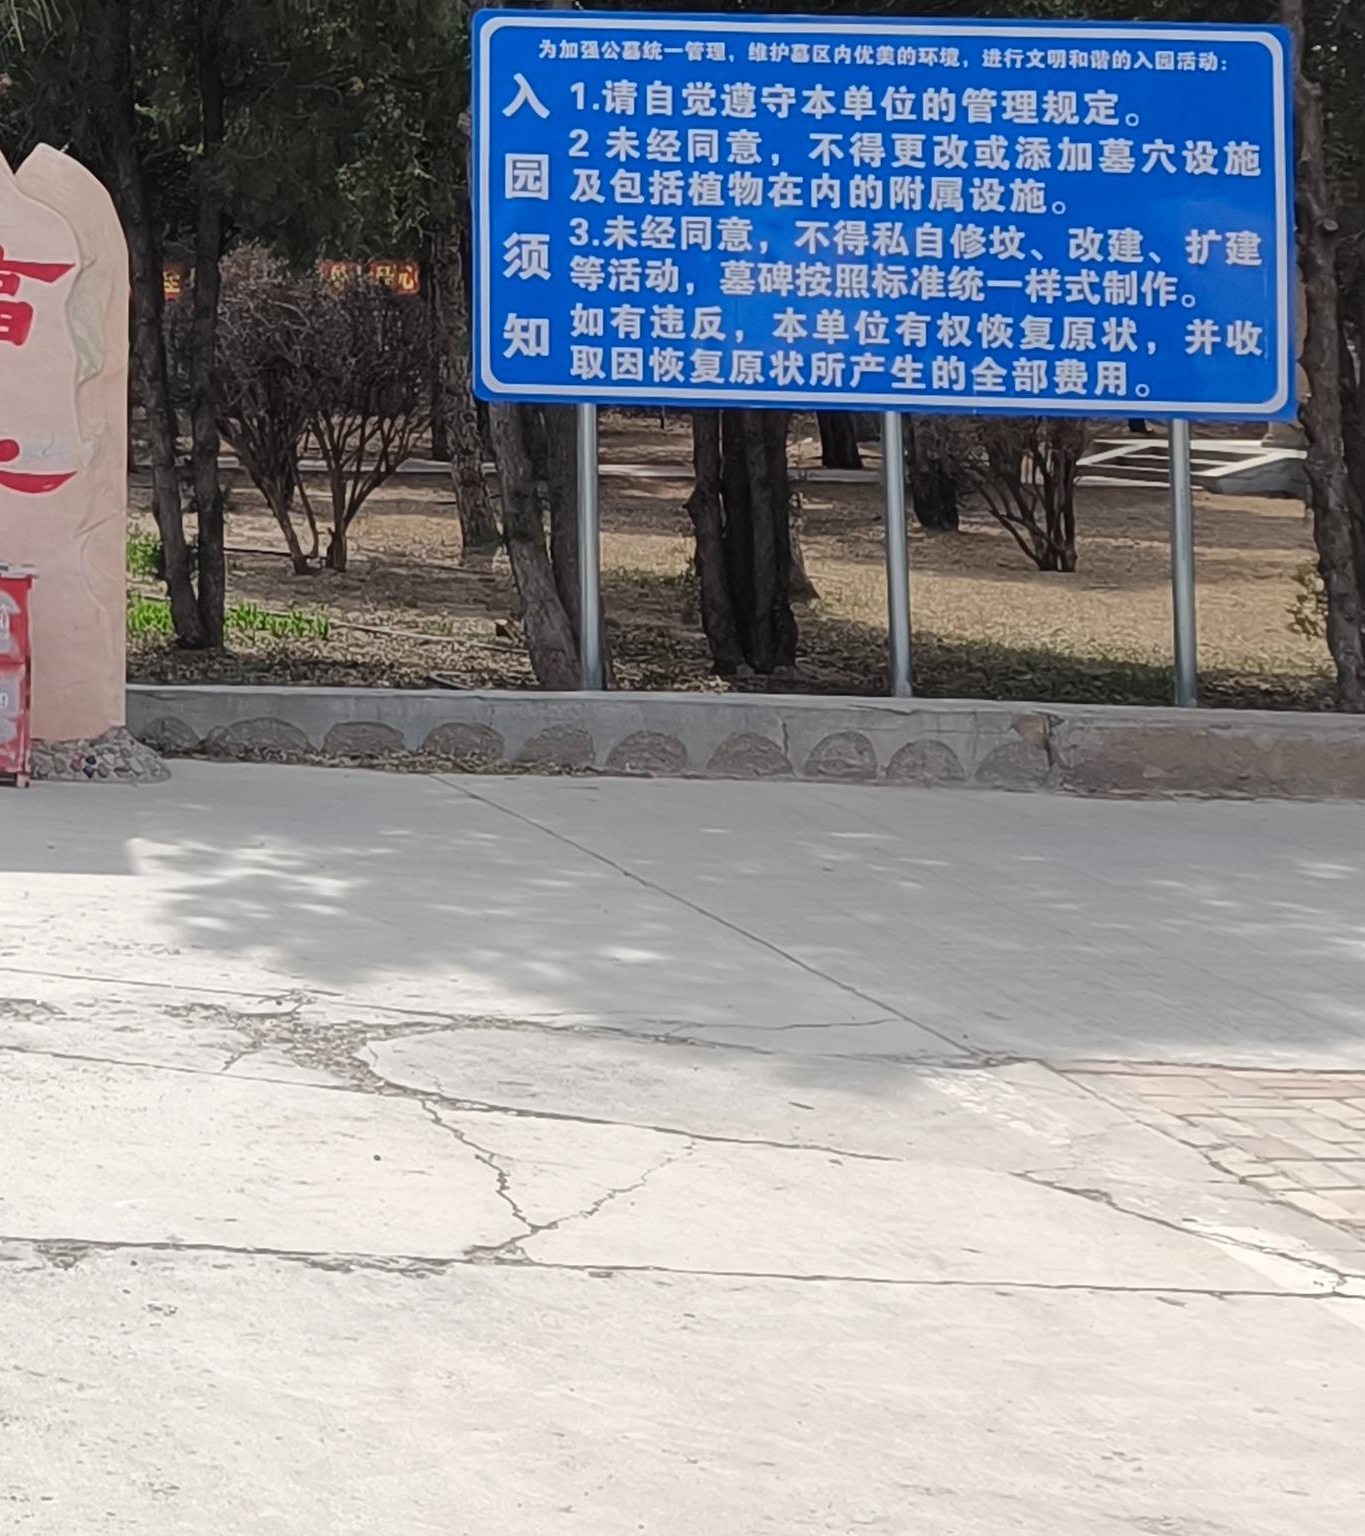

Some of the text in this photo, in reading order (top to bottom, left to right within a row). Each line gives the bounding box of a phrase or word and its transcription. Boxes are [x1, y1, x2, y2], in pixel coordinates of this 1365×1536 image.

[570, 79, 1140, 127] 1.请自觉遵守本单位的管理规定。
[502, 72, 551, 359] 入园须知
[570, 168, 1068, 215] 及包括植物在内的附属设施。
[570, 255, 1197, 308] 等活动，墓碑按照标准统一样式制作。
[570, 345, 1151, 398] 取因恢复原状所产生的全部费用。
